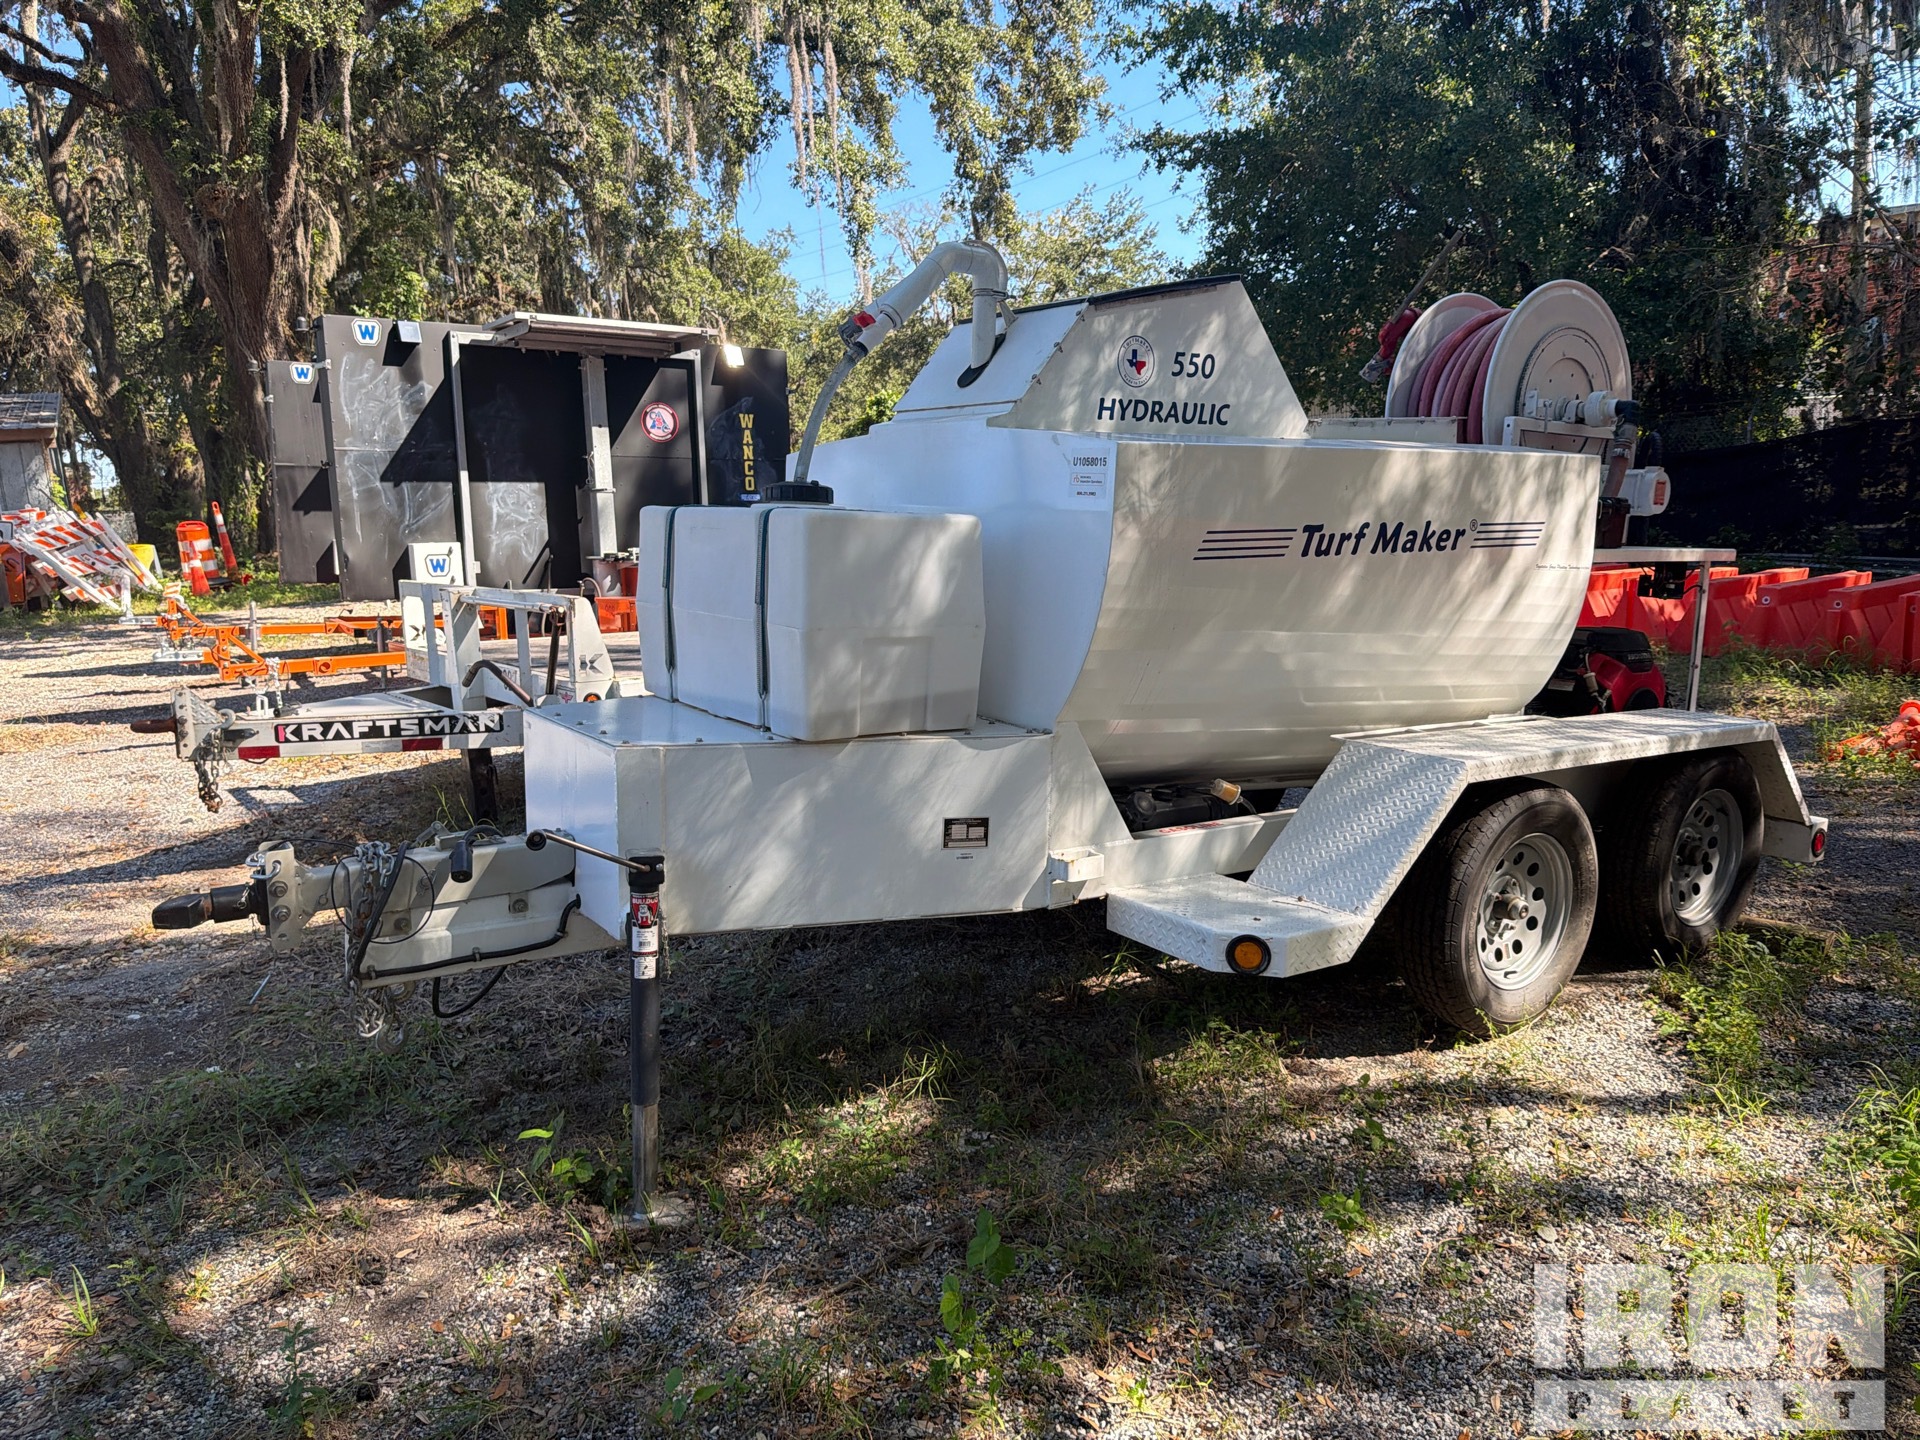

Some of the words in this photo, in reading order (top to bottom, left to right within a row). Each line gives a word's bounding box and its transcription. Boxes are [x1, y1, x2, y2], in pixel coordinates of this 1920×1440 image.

[357, 324, 375, 341] W
[294, 366, 310, 380] W
[1171, 351, 1216, 379] 550
[1097, 397, 1231, 426] HYDRAULIC
[738, 413, 755, 491] WANCO
[1073, 456, 1107, 467] U1058015
[1301, 521, 1370, 558] Turf
[429, 558, 447, 573] W
[278, 713, 501, 742] KRAFTSMAN
